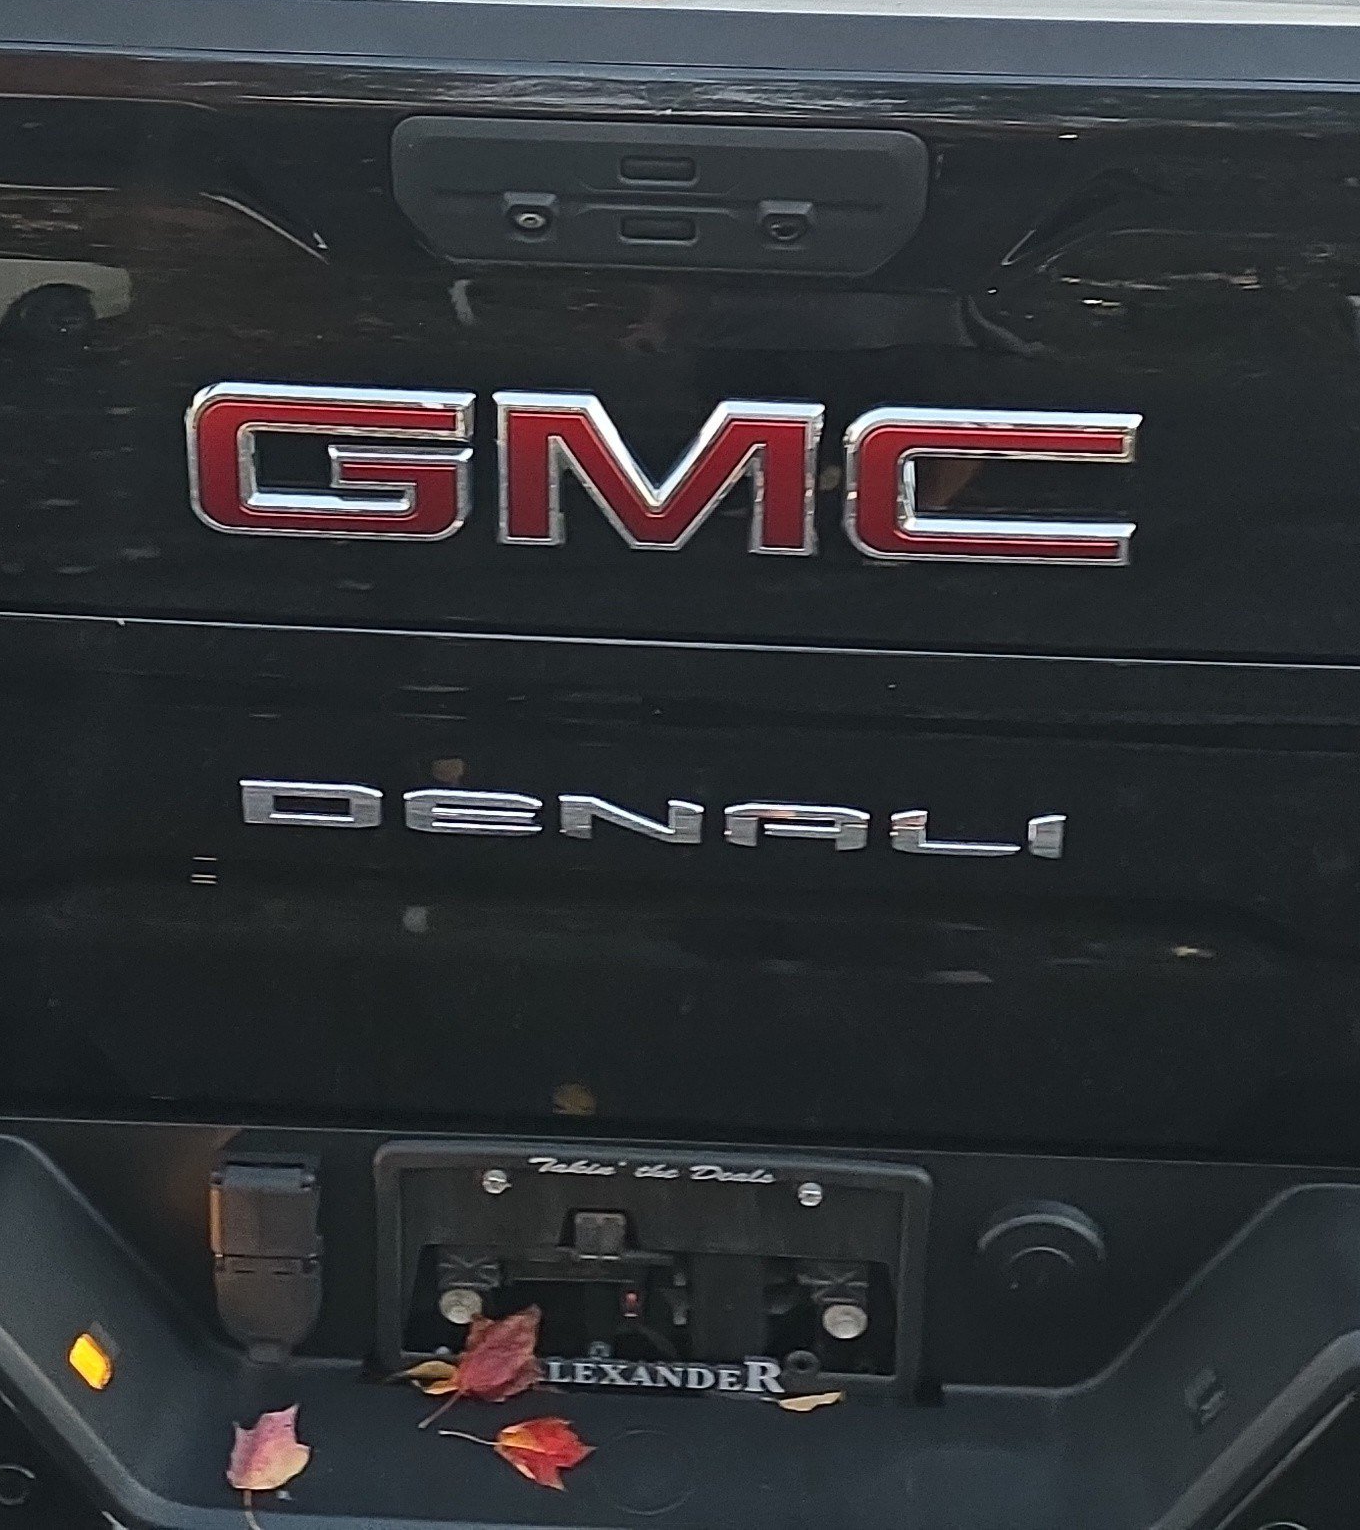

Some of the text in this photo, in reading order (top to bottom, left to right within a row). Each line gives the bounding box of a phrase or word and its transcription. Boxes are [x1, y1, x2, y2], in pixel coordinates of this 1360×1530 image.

[186, 382, 1142, 566] GMC
[239, 778, 1067, 860] DENALI
[633, 1164, 680, 1179] the
[689, 1165, 776, 1184] Deals
[538, 1358, 786, 1393] LEXANDER
